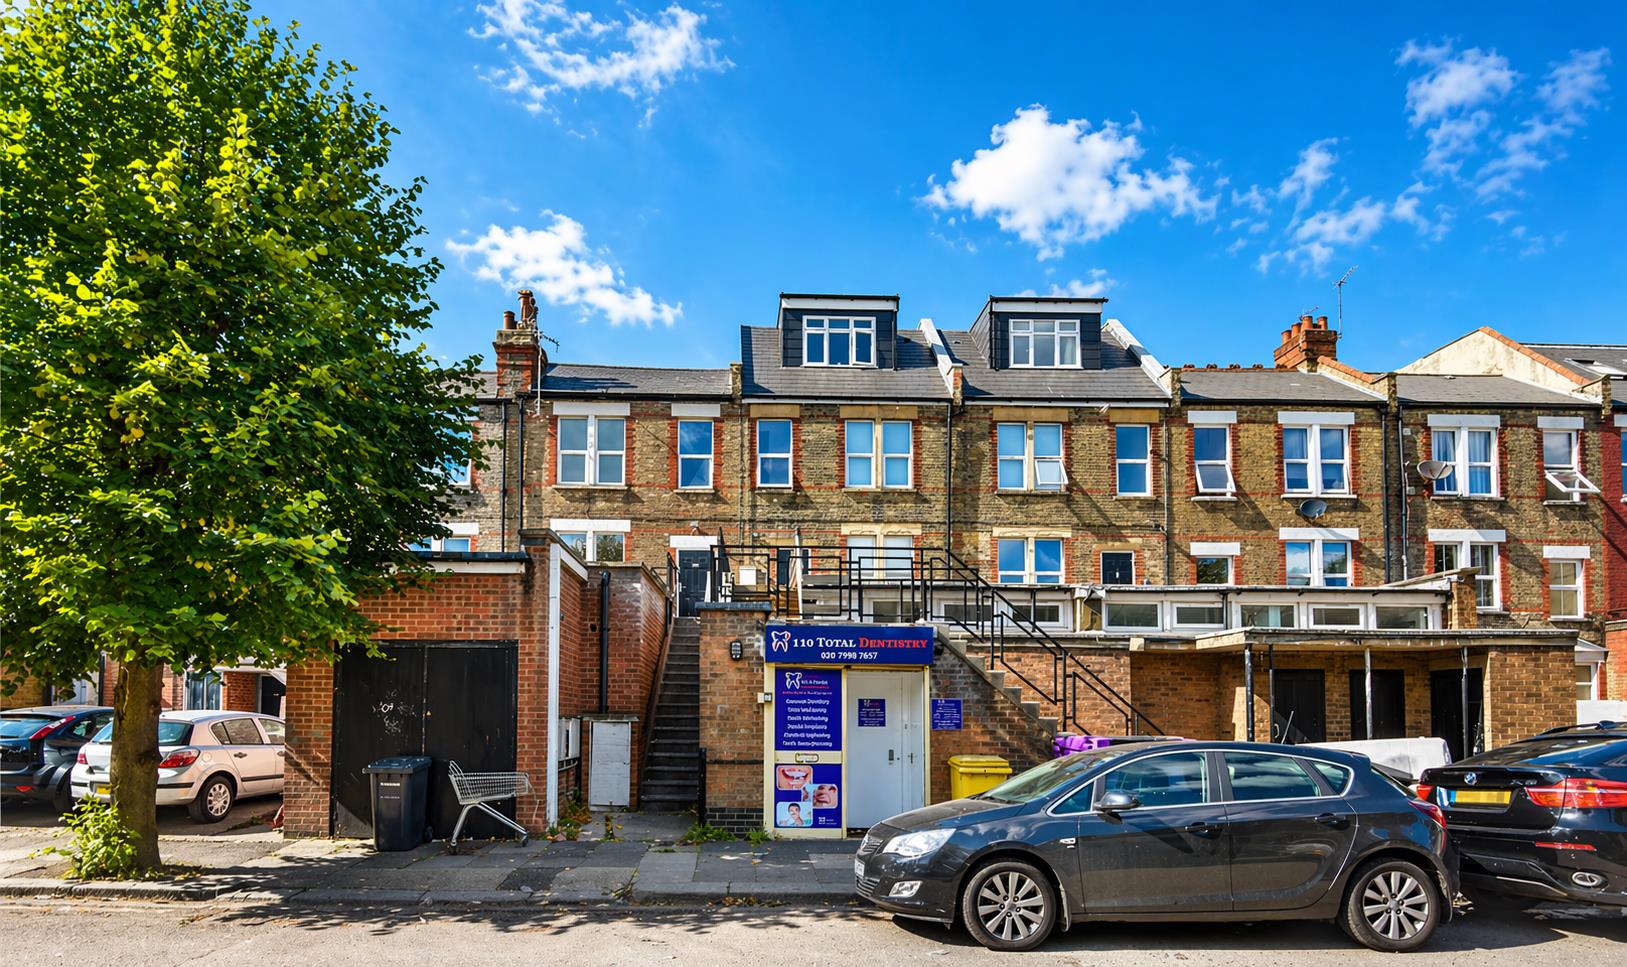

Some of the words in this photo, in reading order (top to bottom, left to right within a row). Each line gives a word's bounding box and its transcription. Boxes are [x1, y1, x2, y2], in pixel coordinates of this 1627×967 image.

[793, 638, 814, 648] 110
[838, 651, 857, 660] 7998
[859, 651, 878, 660] 7657
